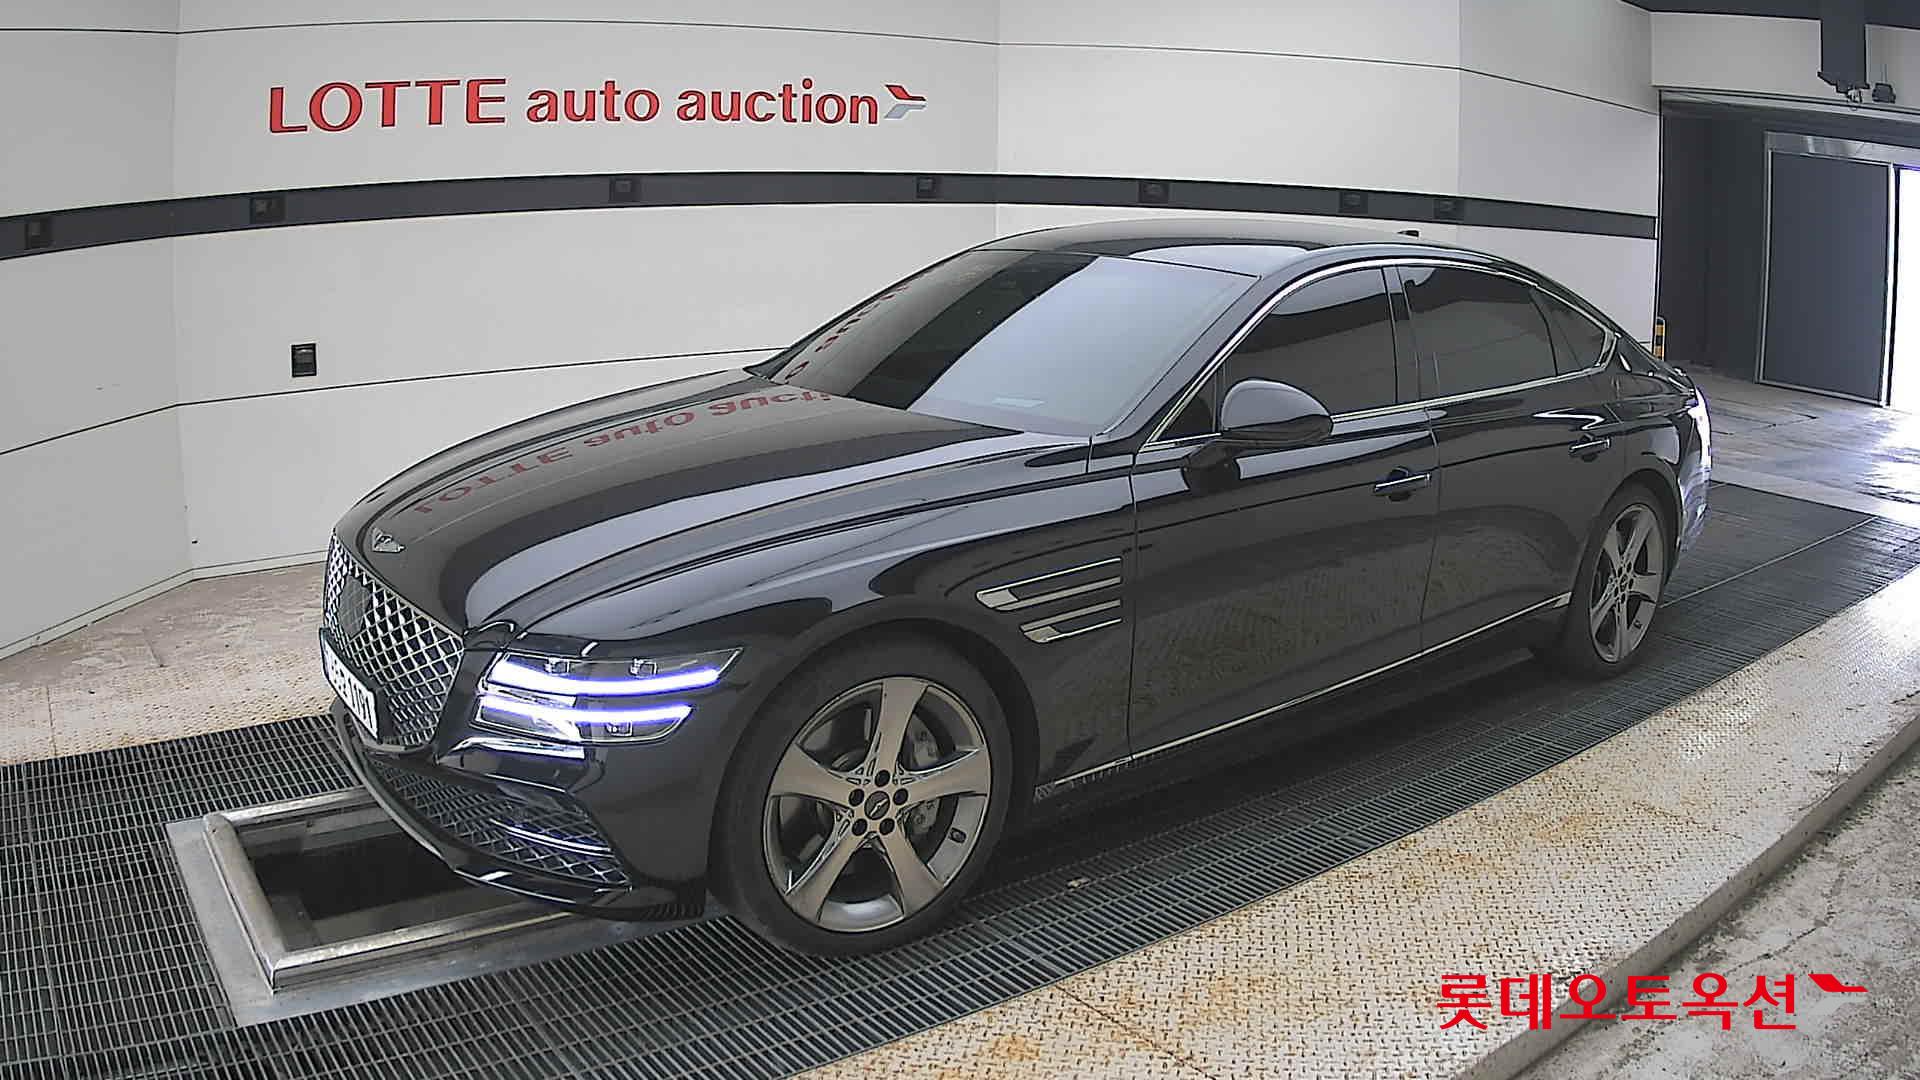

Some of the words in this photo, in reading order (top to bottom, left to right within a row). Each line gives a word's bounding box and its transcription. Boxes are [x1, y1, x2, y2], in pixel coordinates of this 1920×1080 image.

[267, 78, 507, 134] LOTTE
[526, 80, 661, 124] auto
[675, 79, 879, 125] auction
